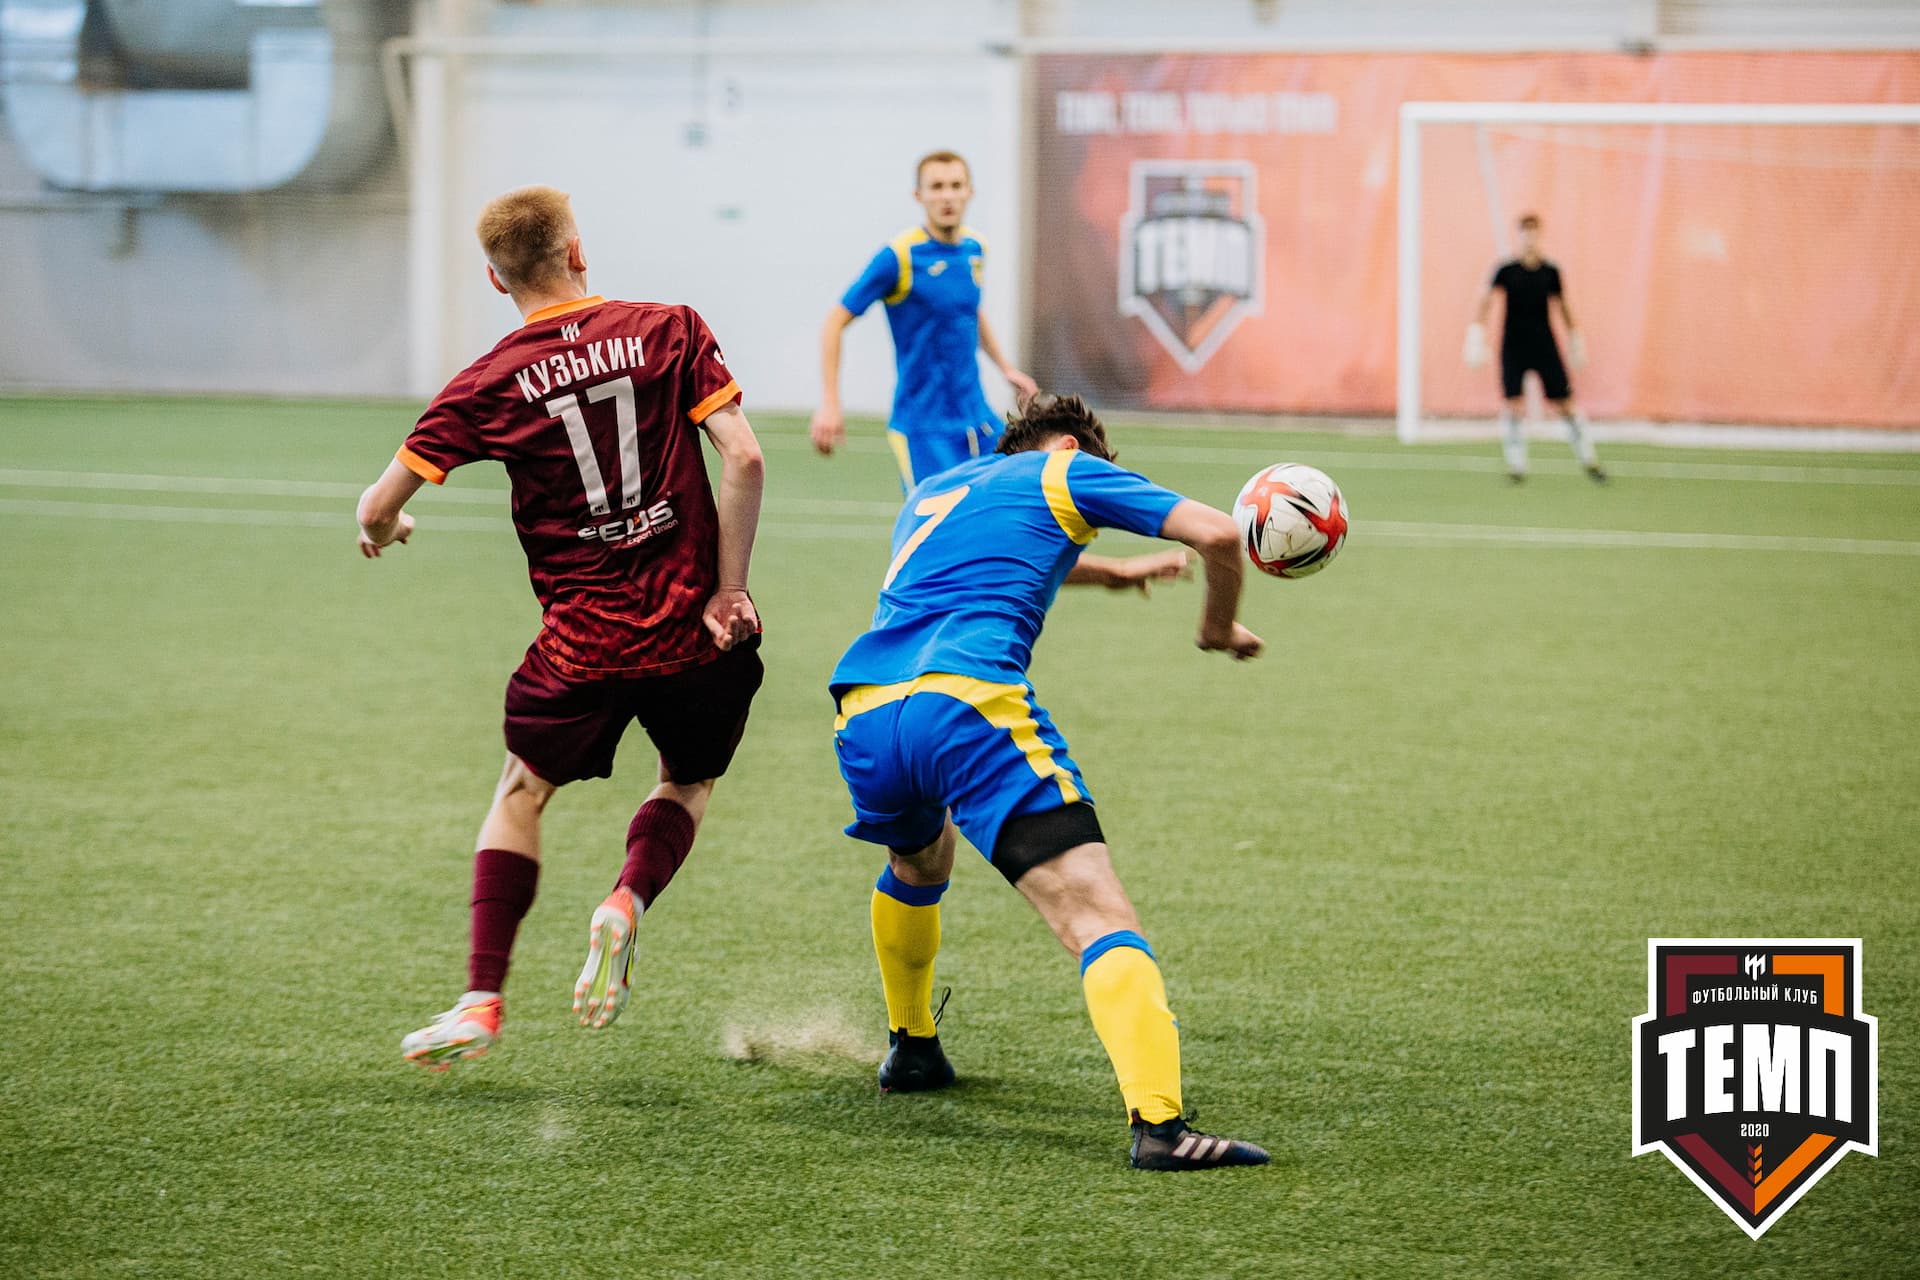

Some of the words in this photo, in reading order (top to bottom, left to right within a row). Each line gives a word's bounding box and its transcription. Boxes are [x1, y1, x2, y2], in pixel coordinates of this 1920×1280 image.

[515, 336, 645, 403] КУЗЬКИН
[545, 375, 642, 516] 17
[627, 530, 652, 545] Export
[653, 519, 679, 534] Union
[882, 485, 970, 590] 7
